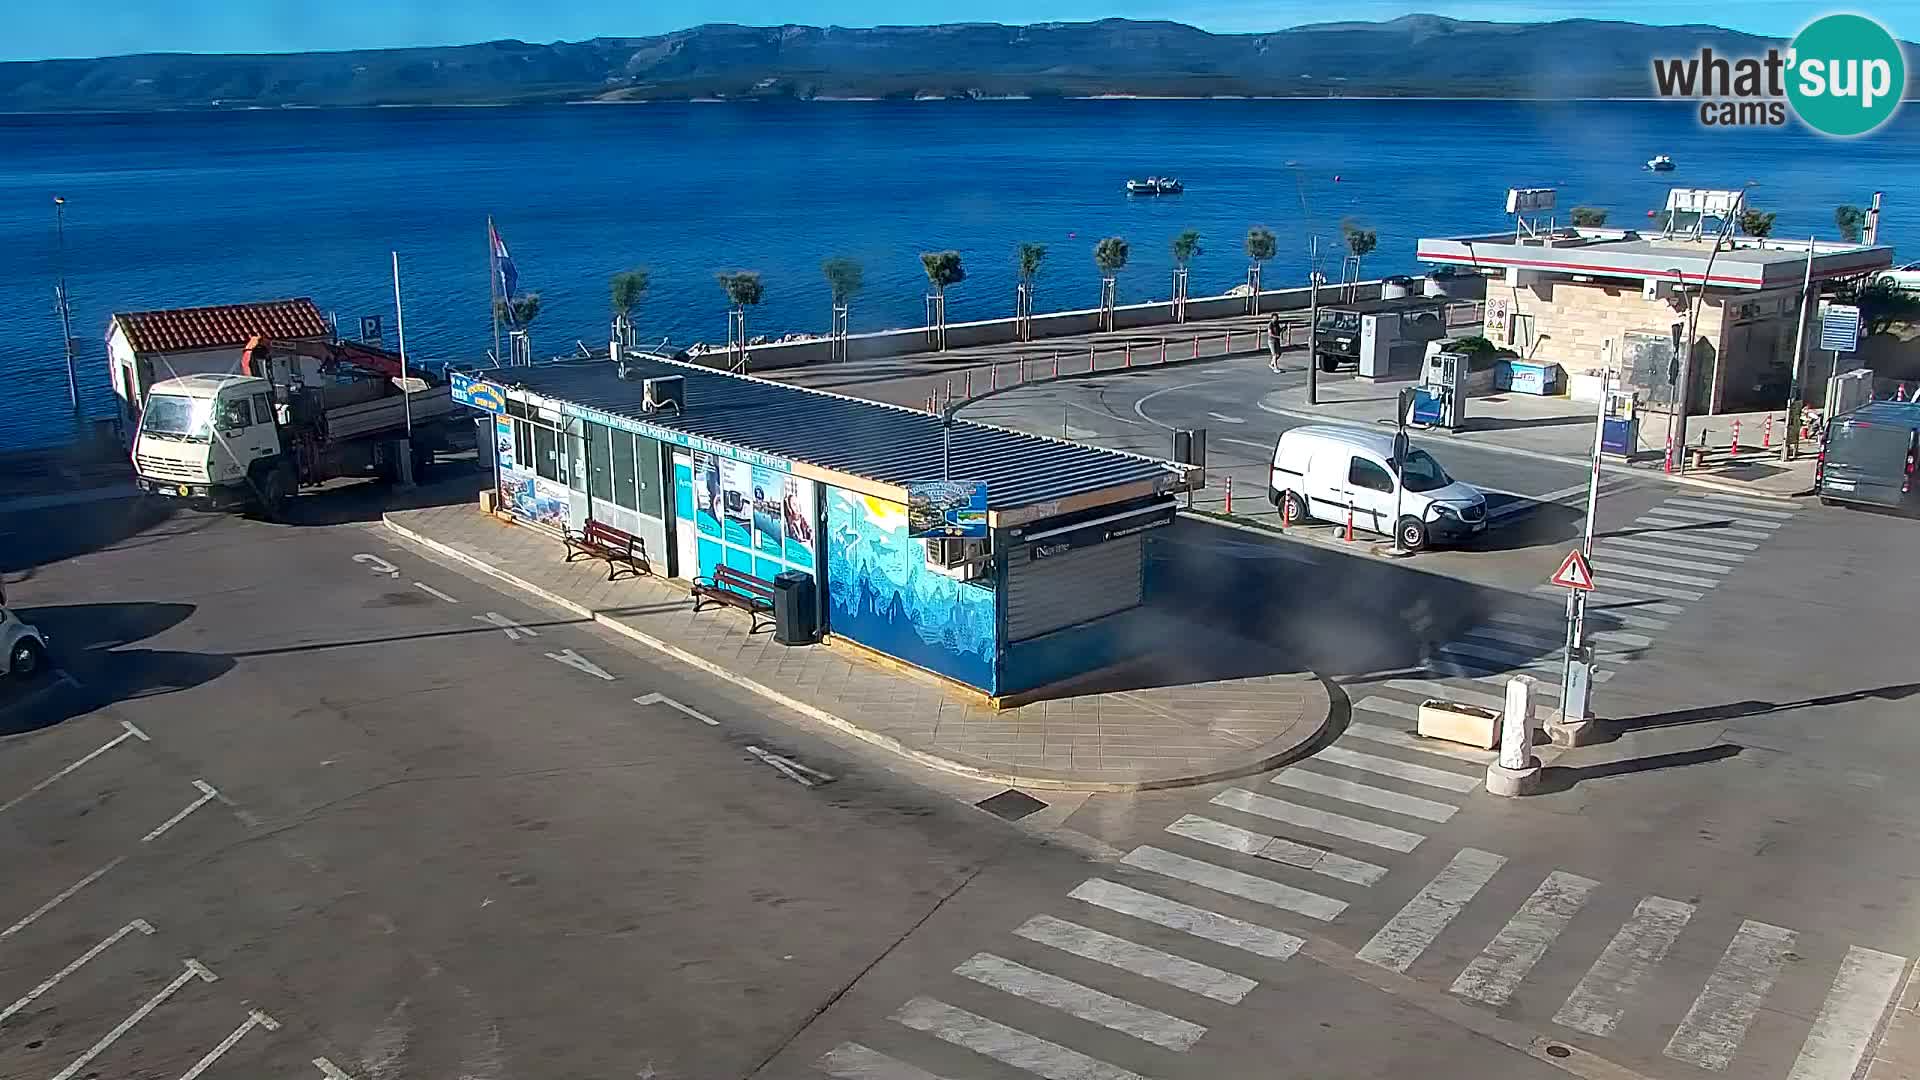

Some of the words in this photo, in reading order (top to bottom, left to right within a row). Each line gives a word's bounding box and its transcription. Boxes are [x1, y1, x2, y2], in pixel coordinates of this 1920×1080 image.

[365, 319, 375, 336] P
[688, 438, 701, 450] BUS
[703, 441, 733, 457] STATION
[736, 449, 760, 465] TICKET
[762, 456, 787, 471] OFFICE
